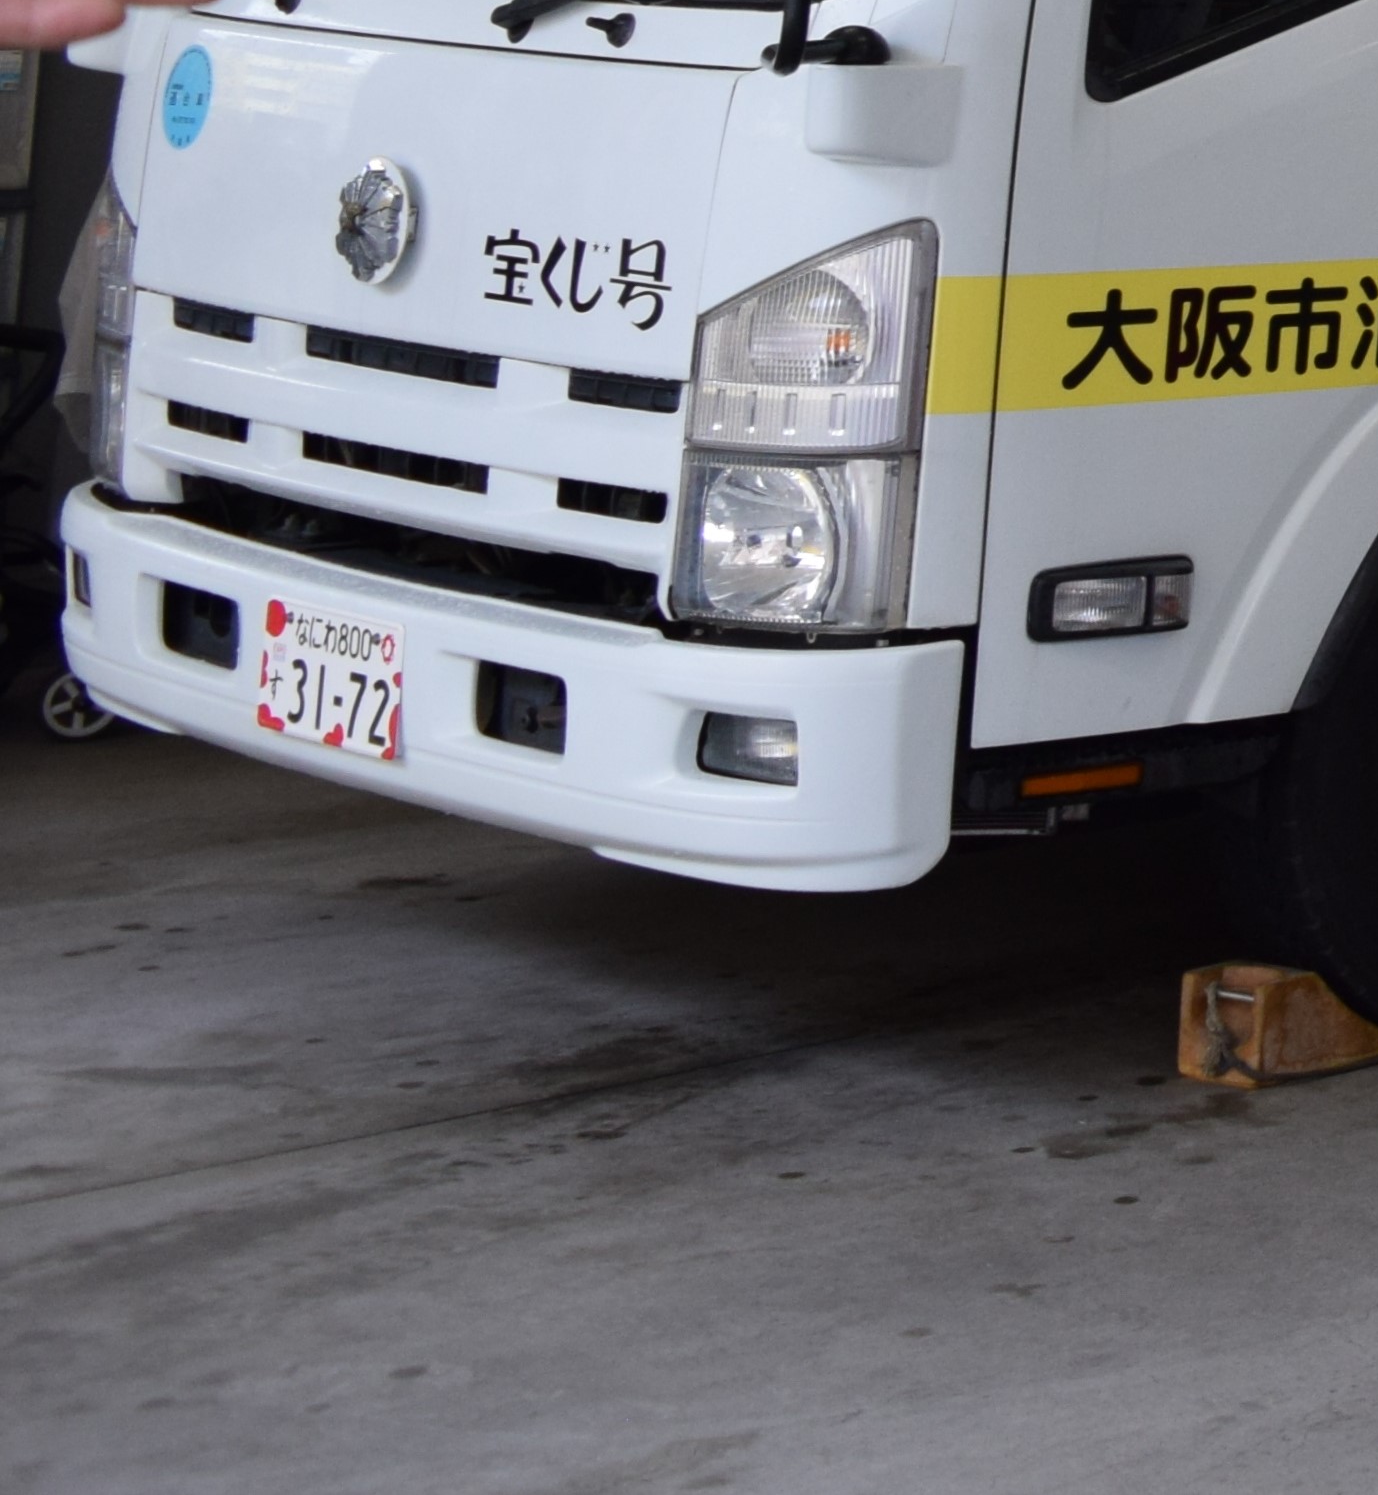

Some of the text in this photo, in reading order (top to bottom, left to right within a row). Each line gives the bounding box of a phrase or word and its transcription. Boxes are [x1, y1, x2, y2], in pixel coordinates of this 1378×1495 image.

[484, 228, 672, 331] 宝くじ号
[269, 658, 390, 747] す 31-72
